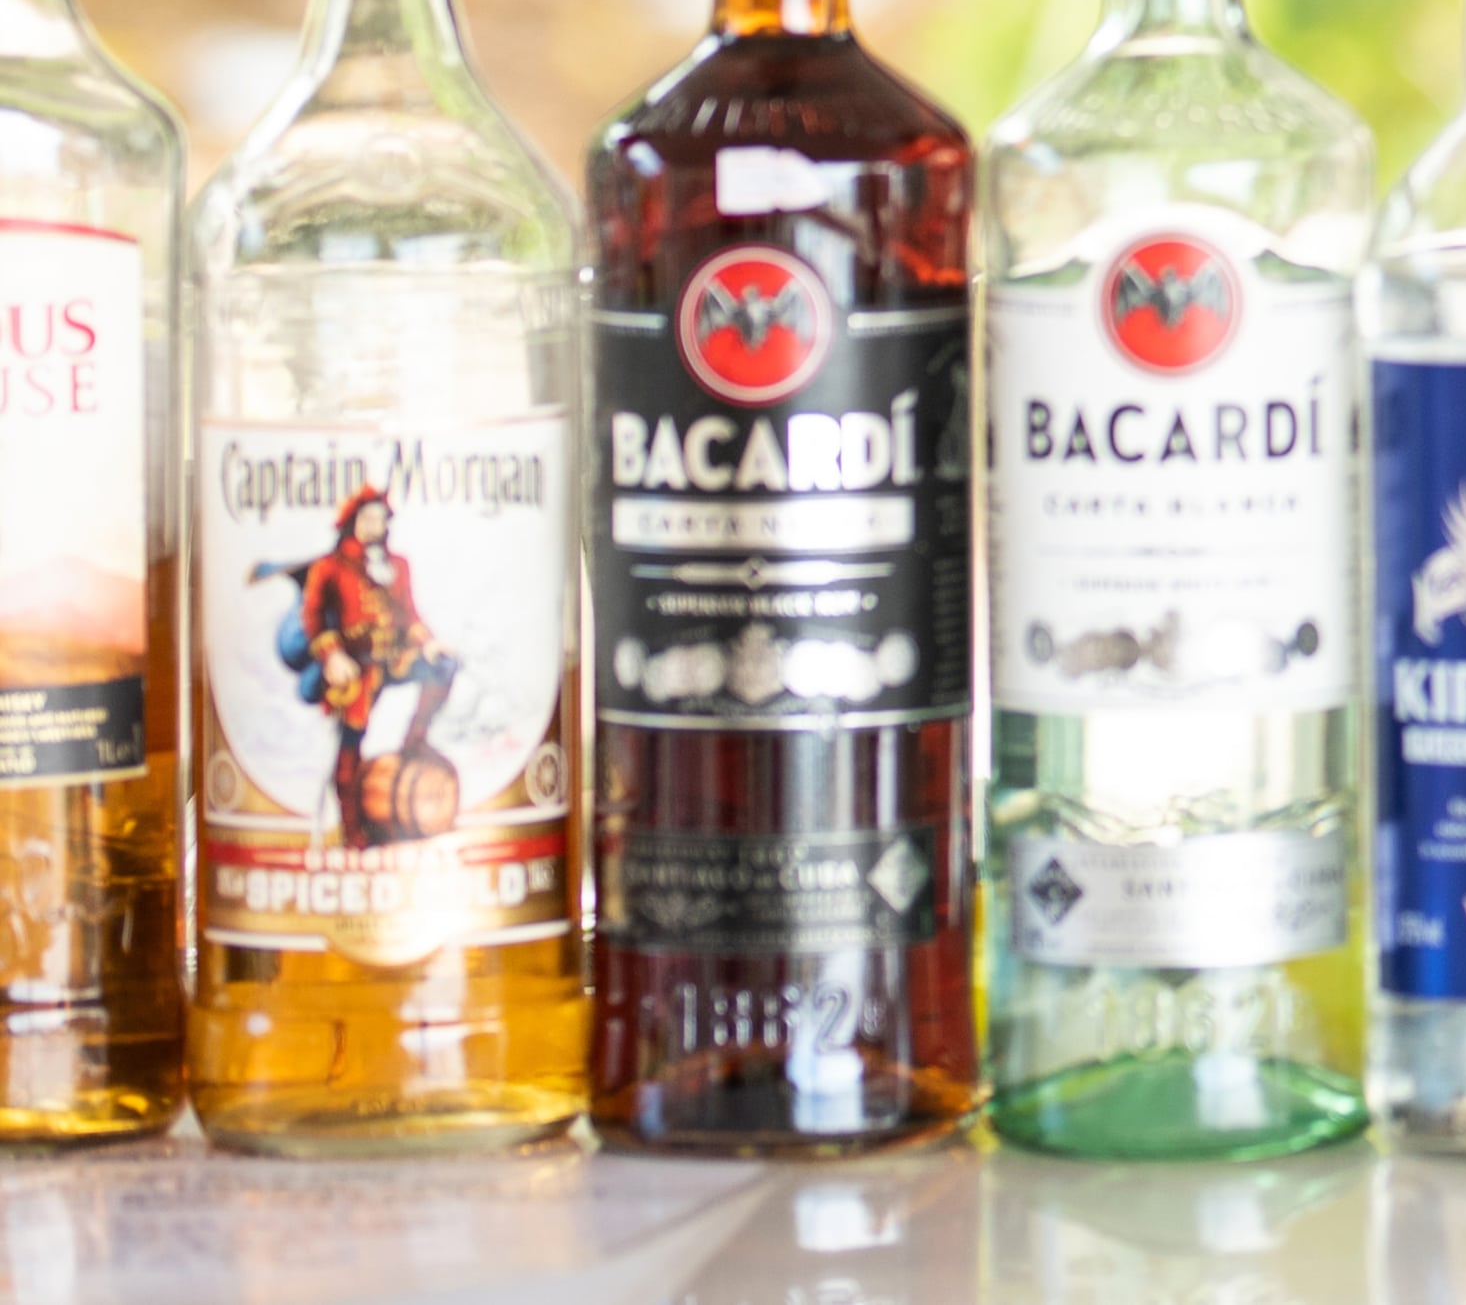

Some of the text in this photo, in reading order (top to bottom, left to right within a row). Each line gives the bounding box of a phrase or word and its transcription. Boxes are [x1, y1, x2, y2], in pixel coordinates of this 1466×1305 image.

[0, 299, 97, 359] US
[611, 389, 920, 492] BACARDÍ
[1024, 375, 1323, 464] BACARDÍ
[220, 436, 547, 524] Captain Morgan
[245, 870, 398, 916] SPICED
